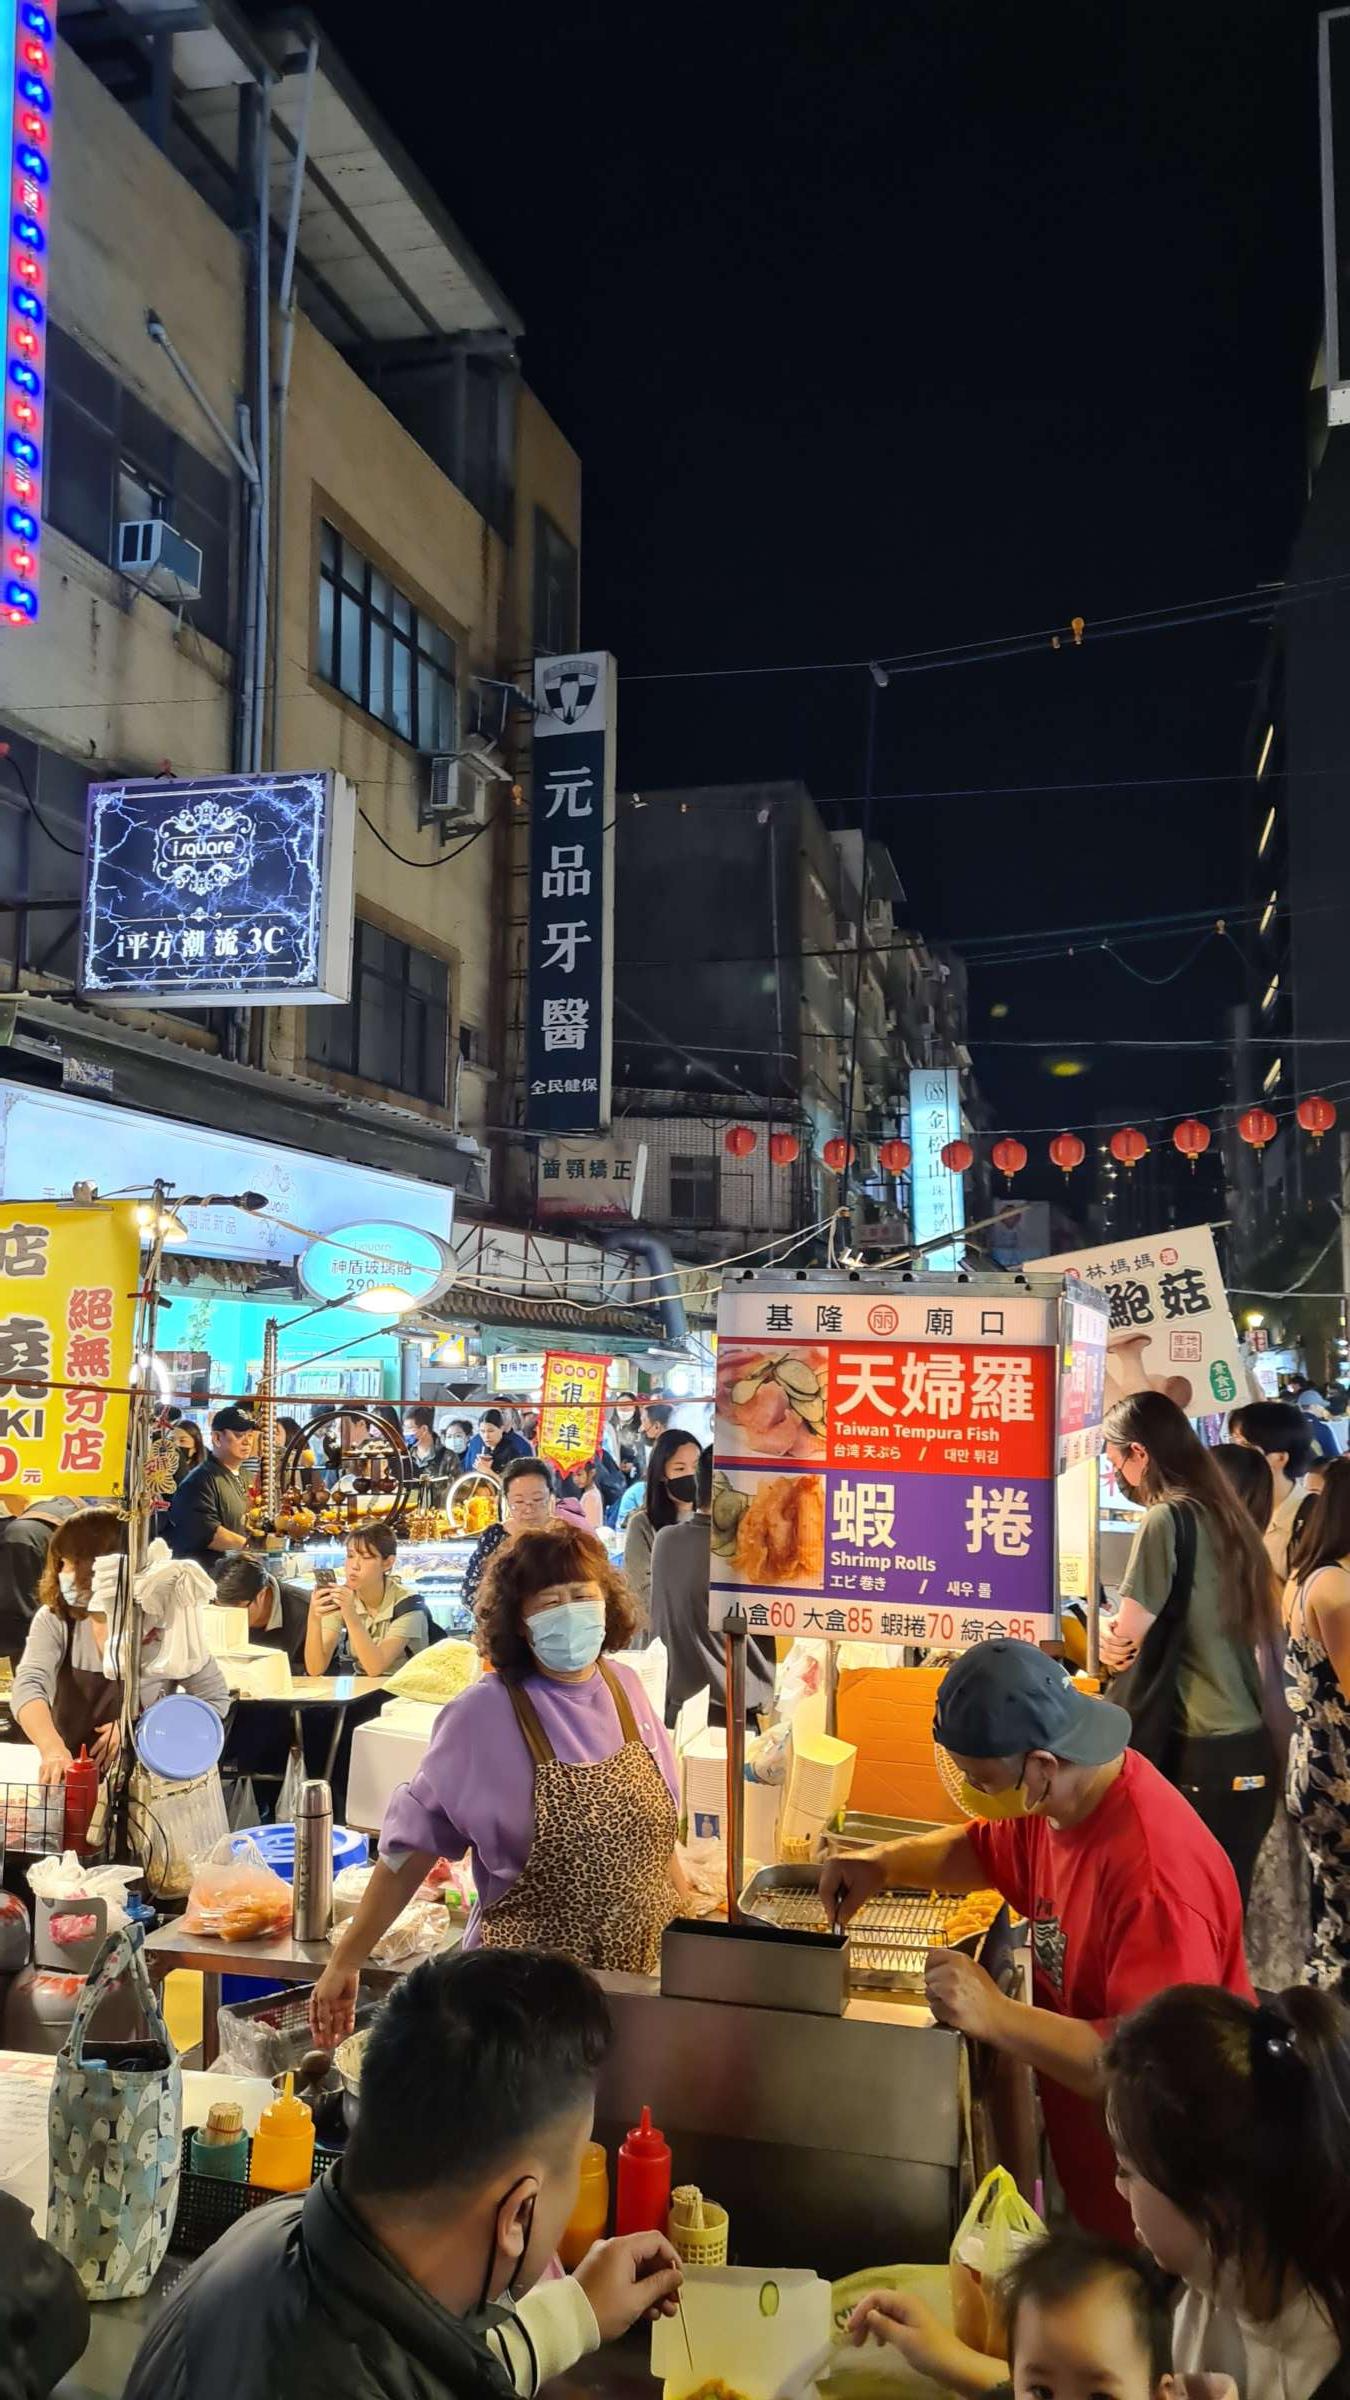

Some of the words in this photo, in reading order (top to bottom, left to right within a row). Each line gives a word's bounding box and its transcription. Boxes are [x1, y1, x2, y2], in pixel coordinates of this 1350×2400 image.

[540, 766, 593, 1052] 元品牙醫
[530, 1078, 598, 1095] 全民健保
[0, 1224, 50, 1276] 店
[1085, 1253, 1156, 1280] 林媽媽
[61, 1288, 113, 1472] 絕無分店
[834, 1352, 1035, 1423] 天婦羅
[834, 1421, 889, 1437] Taiwan
[893, 1424, 963, 1442] Tempura
[967, 1427, 1000, 1442] Fish
[834, 1443, 859, 1458] 台湾
[863, 1445, 901, 1460] 天ぷら
[944, 1448, 969, 1463] 대만
[973, 1449, 999, 1464] 튀김
[831, 1551, 891, 1572] Shrimp
[895, 1555, 937, 1572] Rolls
[946, 1581, 974, 1597] 새우
